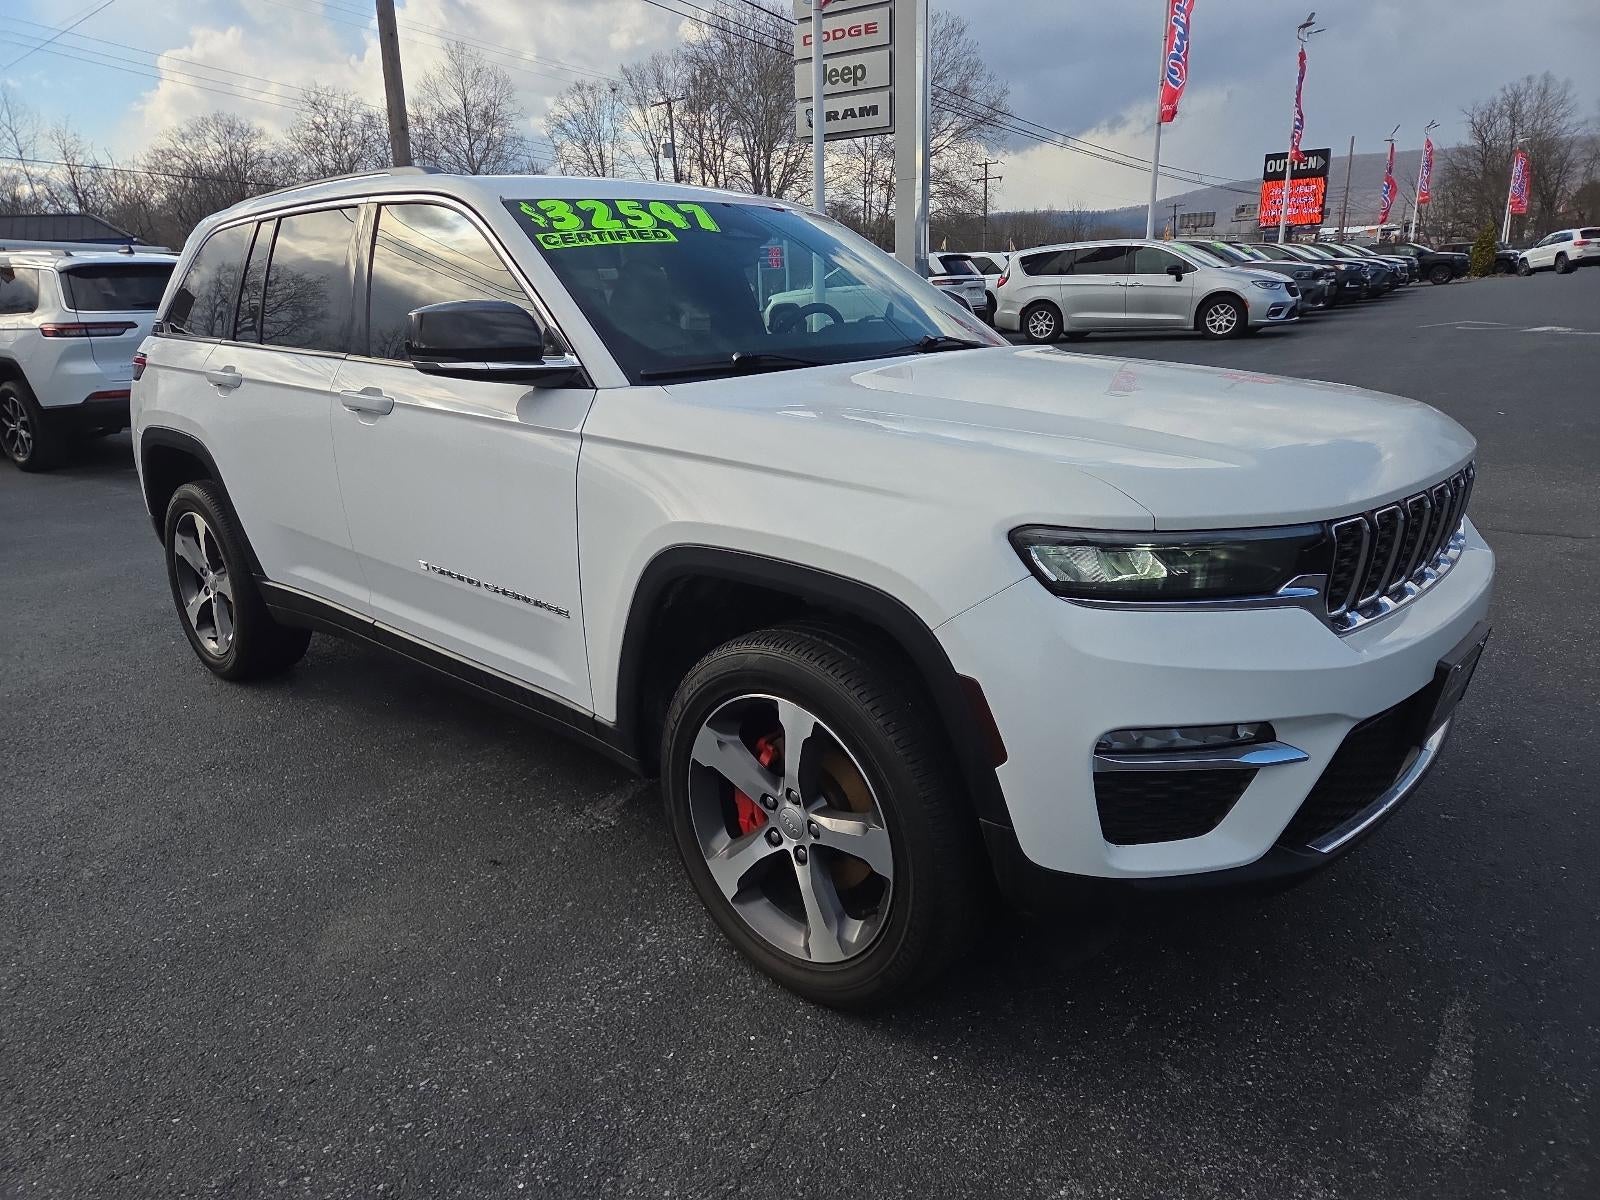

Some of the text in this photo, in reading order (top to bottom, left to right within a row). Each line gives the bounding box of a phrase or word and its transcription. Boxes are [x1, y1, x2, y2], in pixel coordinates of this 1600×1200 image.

[803, 22, 878, 46] DODGE
[826, 105, 878, 122] RAM
[1266, 156, 1317, 173] OUTEN
[519, 199, 721, 232] $32547
[542, 229, 668, 246] CERTIFIED
